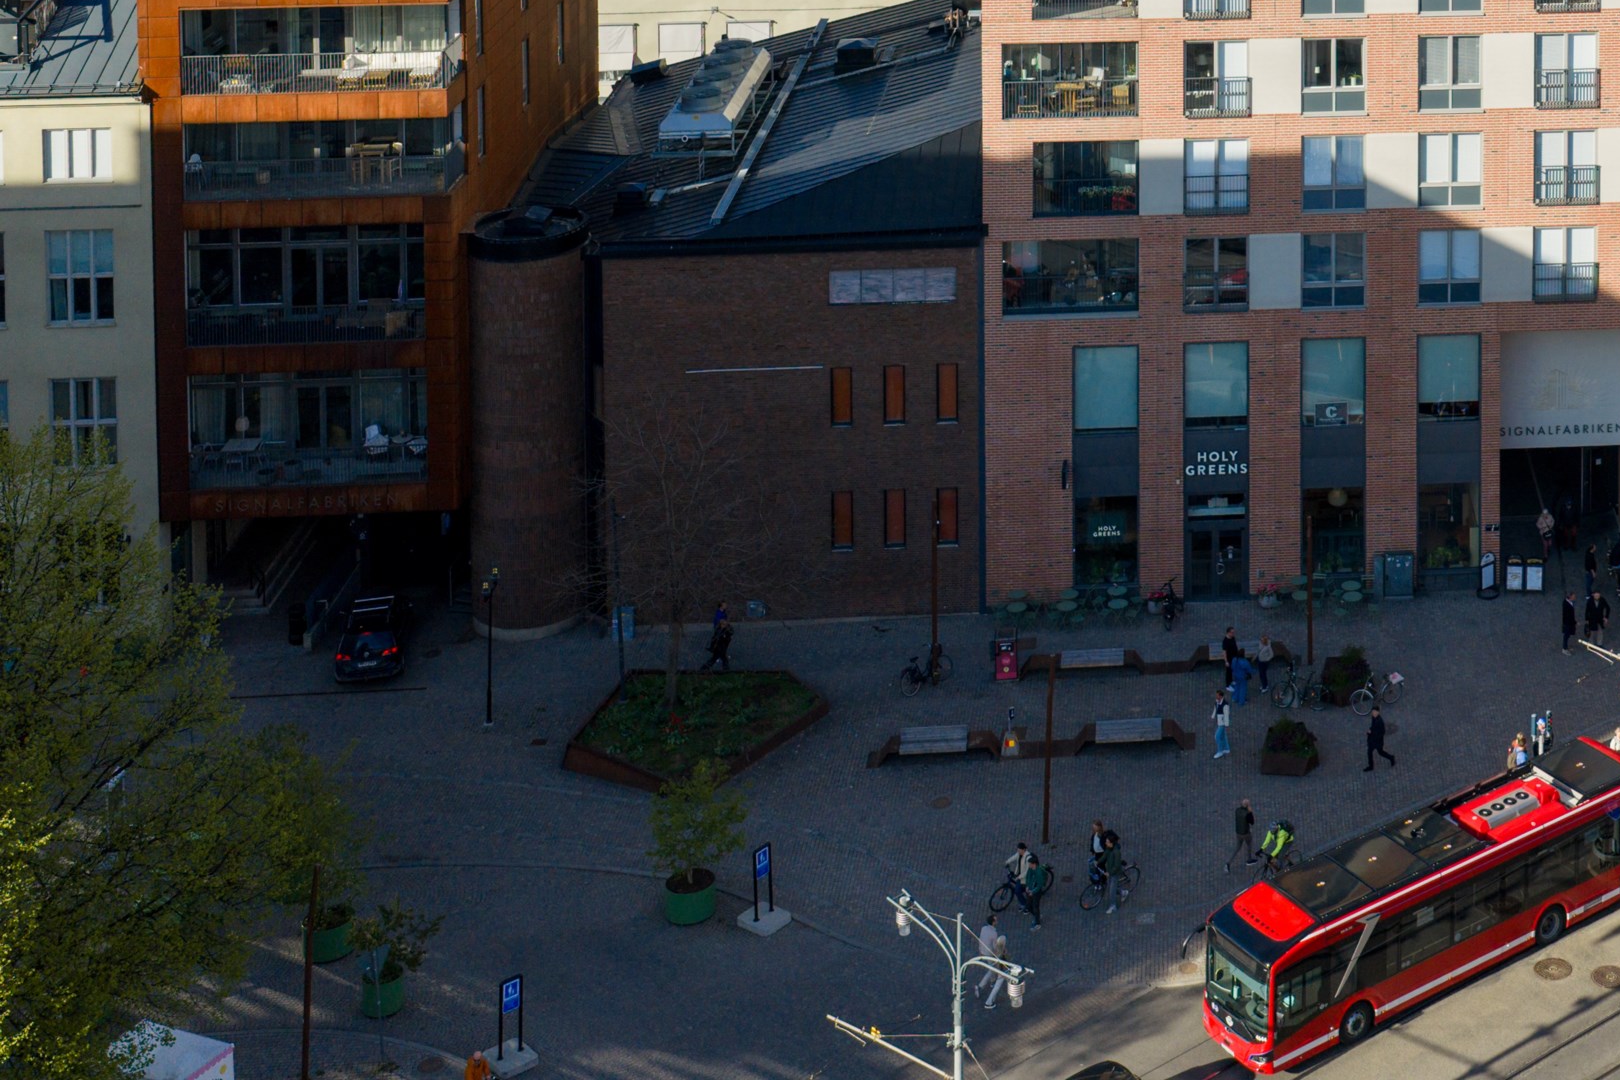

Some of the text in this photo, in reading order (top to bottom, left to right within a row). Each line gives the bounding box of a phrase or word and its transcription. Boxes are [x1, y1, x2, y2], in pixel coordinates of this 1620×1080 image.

[1197, 451, 1239, 462] HOLY
[1185, 463, 1248, 476] GREENS
[215, 493, 398, 513] SIGNALFABRIKEN
